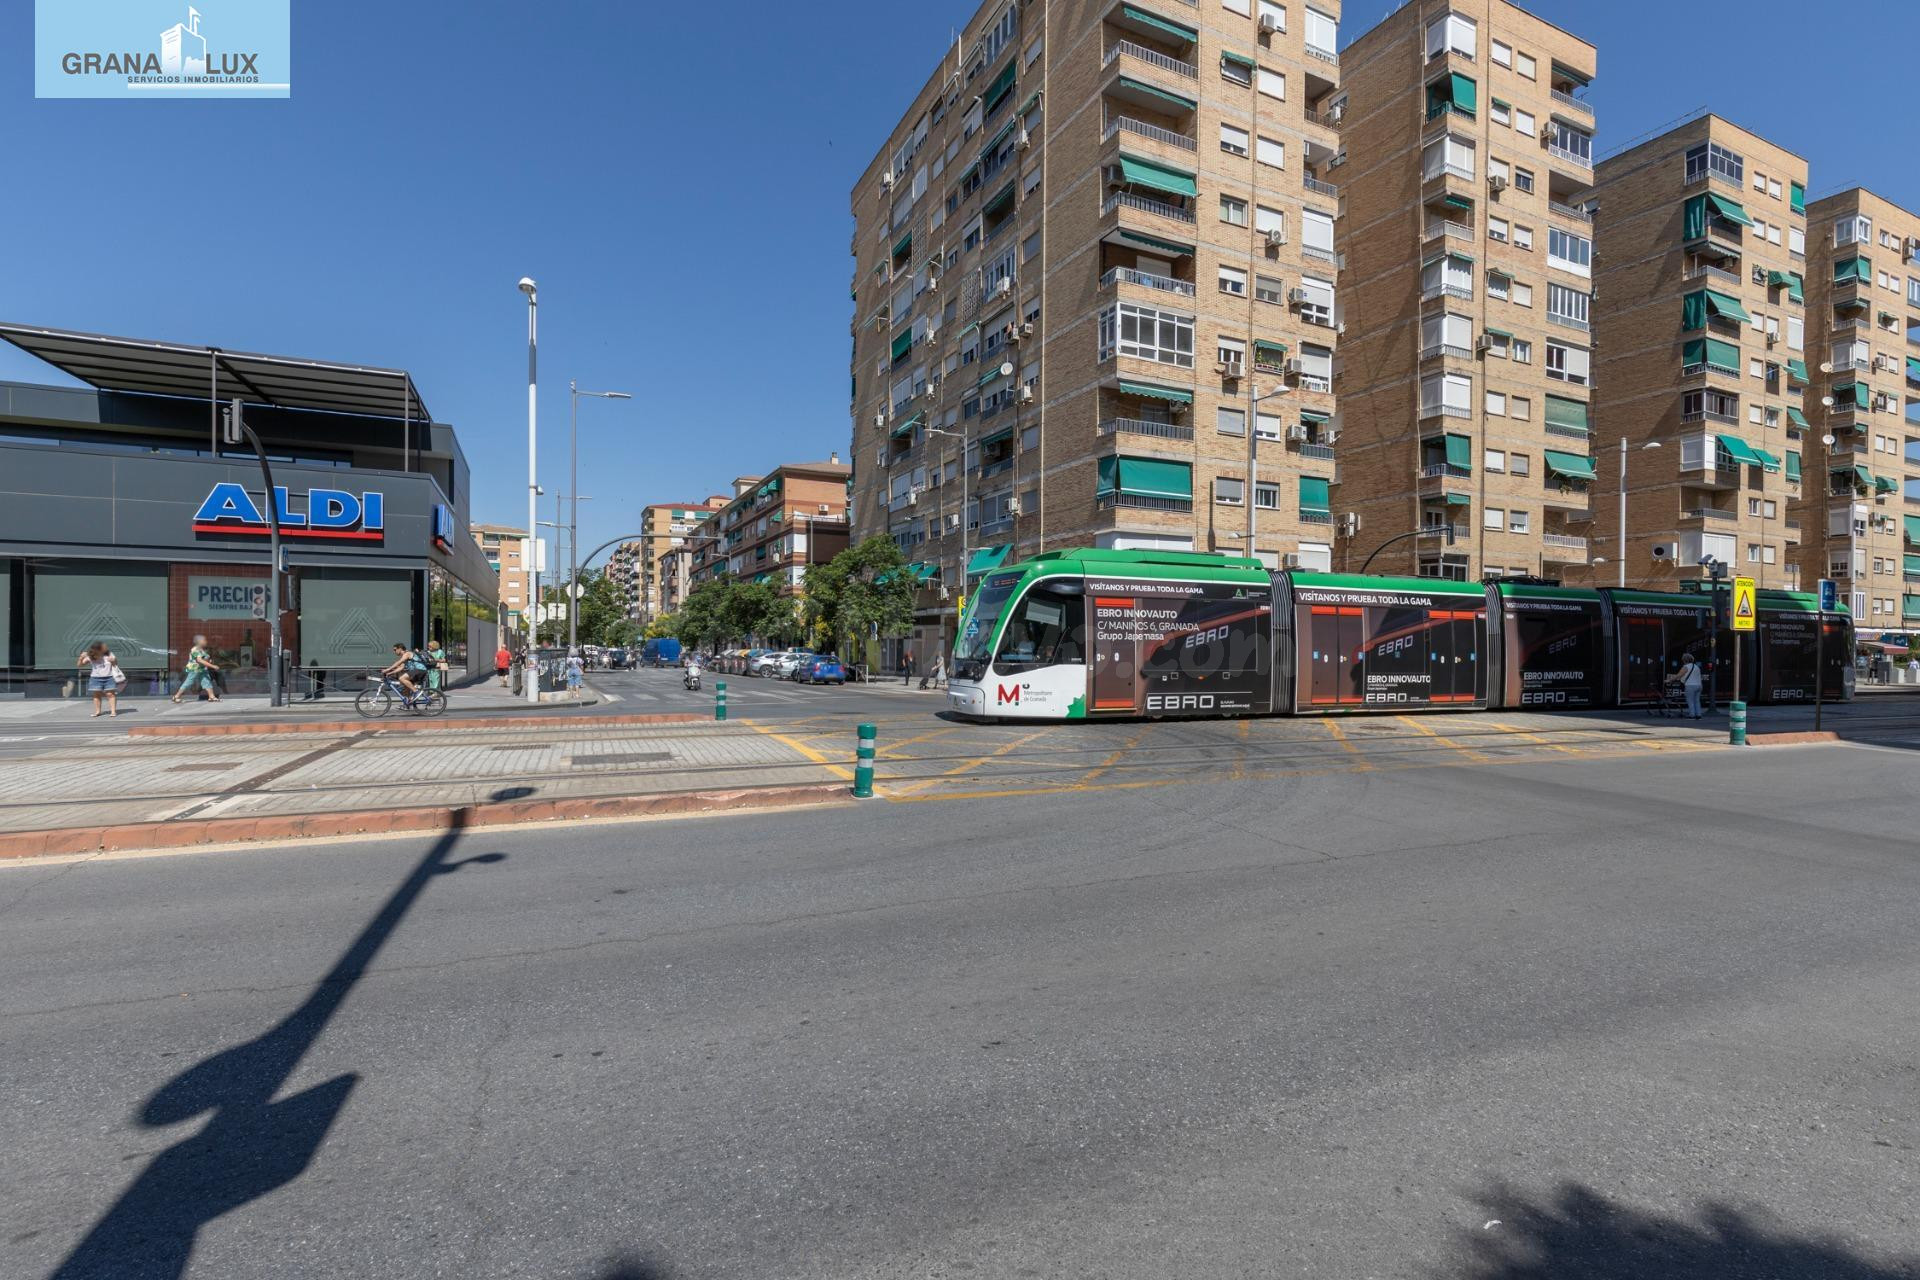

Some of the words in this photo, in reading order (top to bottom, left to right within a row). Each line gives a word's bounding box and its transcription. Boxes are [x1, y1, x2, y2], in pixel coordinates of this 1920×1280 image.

[193, 483, 383, 529] ALDI
[198, 585, 271, 603] PRECIS
[1089, 582, 1125, 591] VISÍTANOS
[1185, 586, 1204, 594] GAMA
[1299, 591, 1340, 602] VISÍTANOS
[1340, 594, 1347, 602] Y
[1347, 595, 1377, 603] PRUEBA
[1378, 596, 1399, 604] TODA
[1400, 597, 1409, 605] LA
[1410, 597, 1432, 606] GAMA
[1097, 609, 1122, 618] EBRO
[1123, 609, 1178, 619] INNOVAUTO
[1097, 621, 1107, 630] C/
[1159, 622, 1200, 631] GRANADA
[1097, 631, 1123, 642] Grupo
[1185, 625, 1229, 648] EBRO
[1378, 635, 1413, 656] EBRO
[1367, 675, 1387, 684] EBRO
[1388, 675, 1430, 684] INNOVAUTO
[1524, 672, 1543, 680] EBRO
[1544, 672, 1583, 680] INNOVAUTO
[1366, 693, 1407, 703] EBRO
[1522, 692, 1565, 704] EBRO
[1772, 689, 1804, 699] EBRO
[1147, 695, 1214, 710] EBRO
